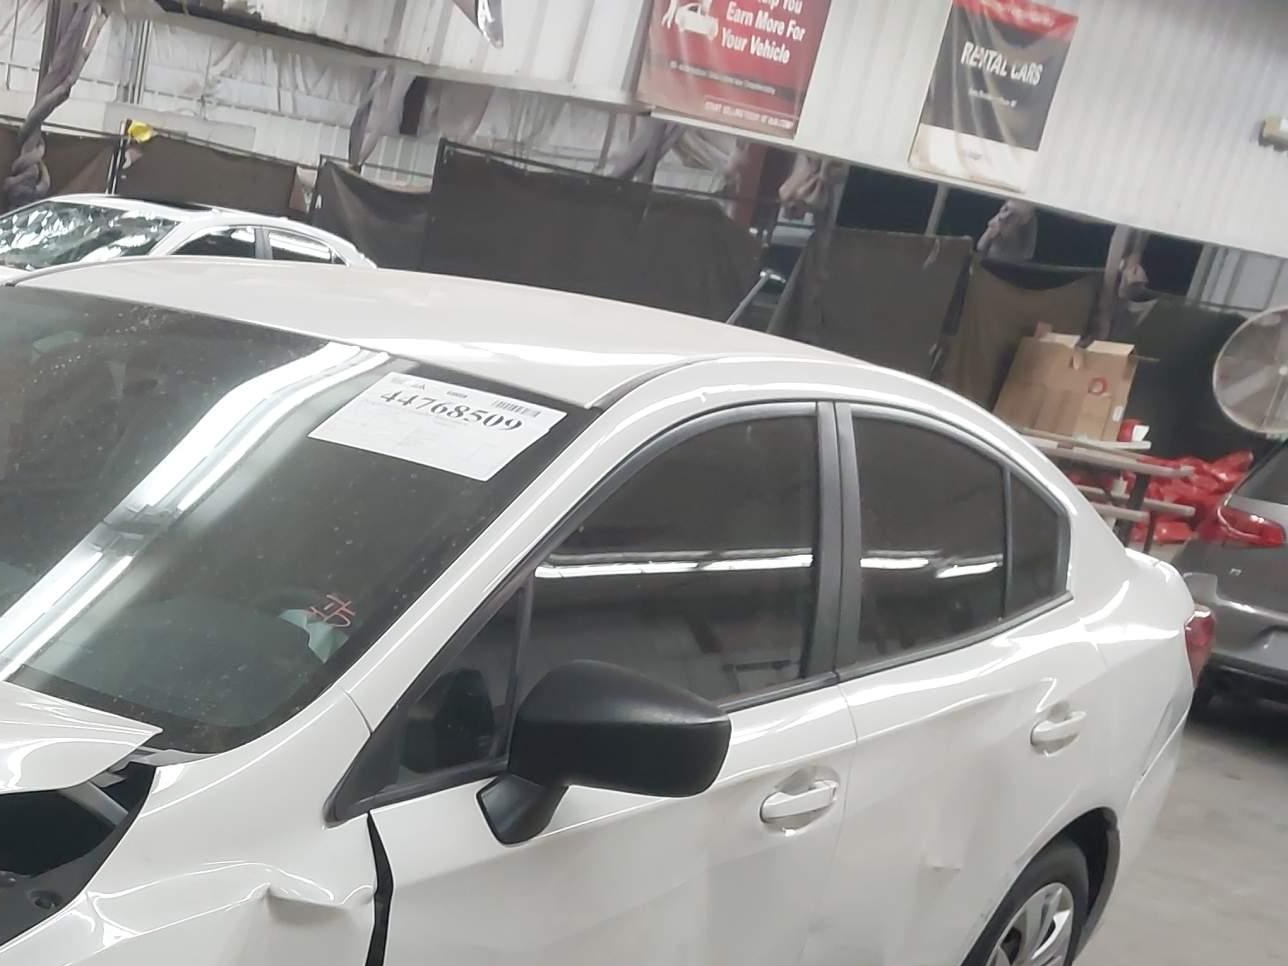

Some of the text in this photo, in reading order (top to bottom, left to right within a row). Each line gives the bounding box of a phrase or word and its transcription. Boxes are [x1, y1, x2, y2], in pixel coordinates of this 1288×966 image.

[726, 1, 806, 41] Earn More For
[721, 27, 791, 64] Your Vehicle
[961, 41, 1044, 86] RENTAL CARS
[380, 390, 523, 431] 44768509
